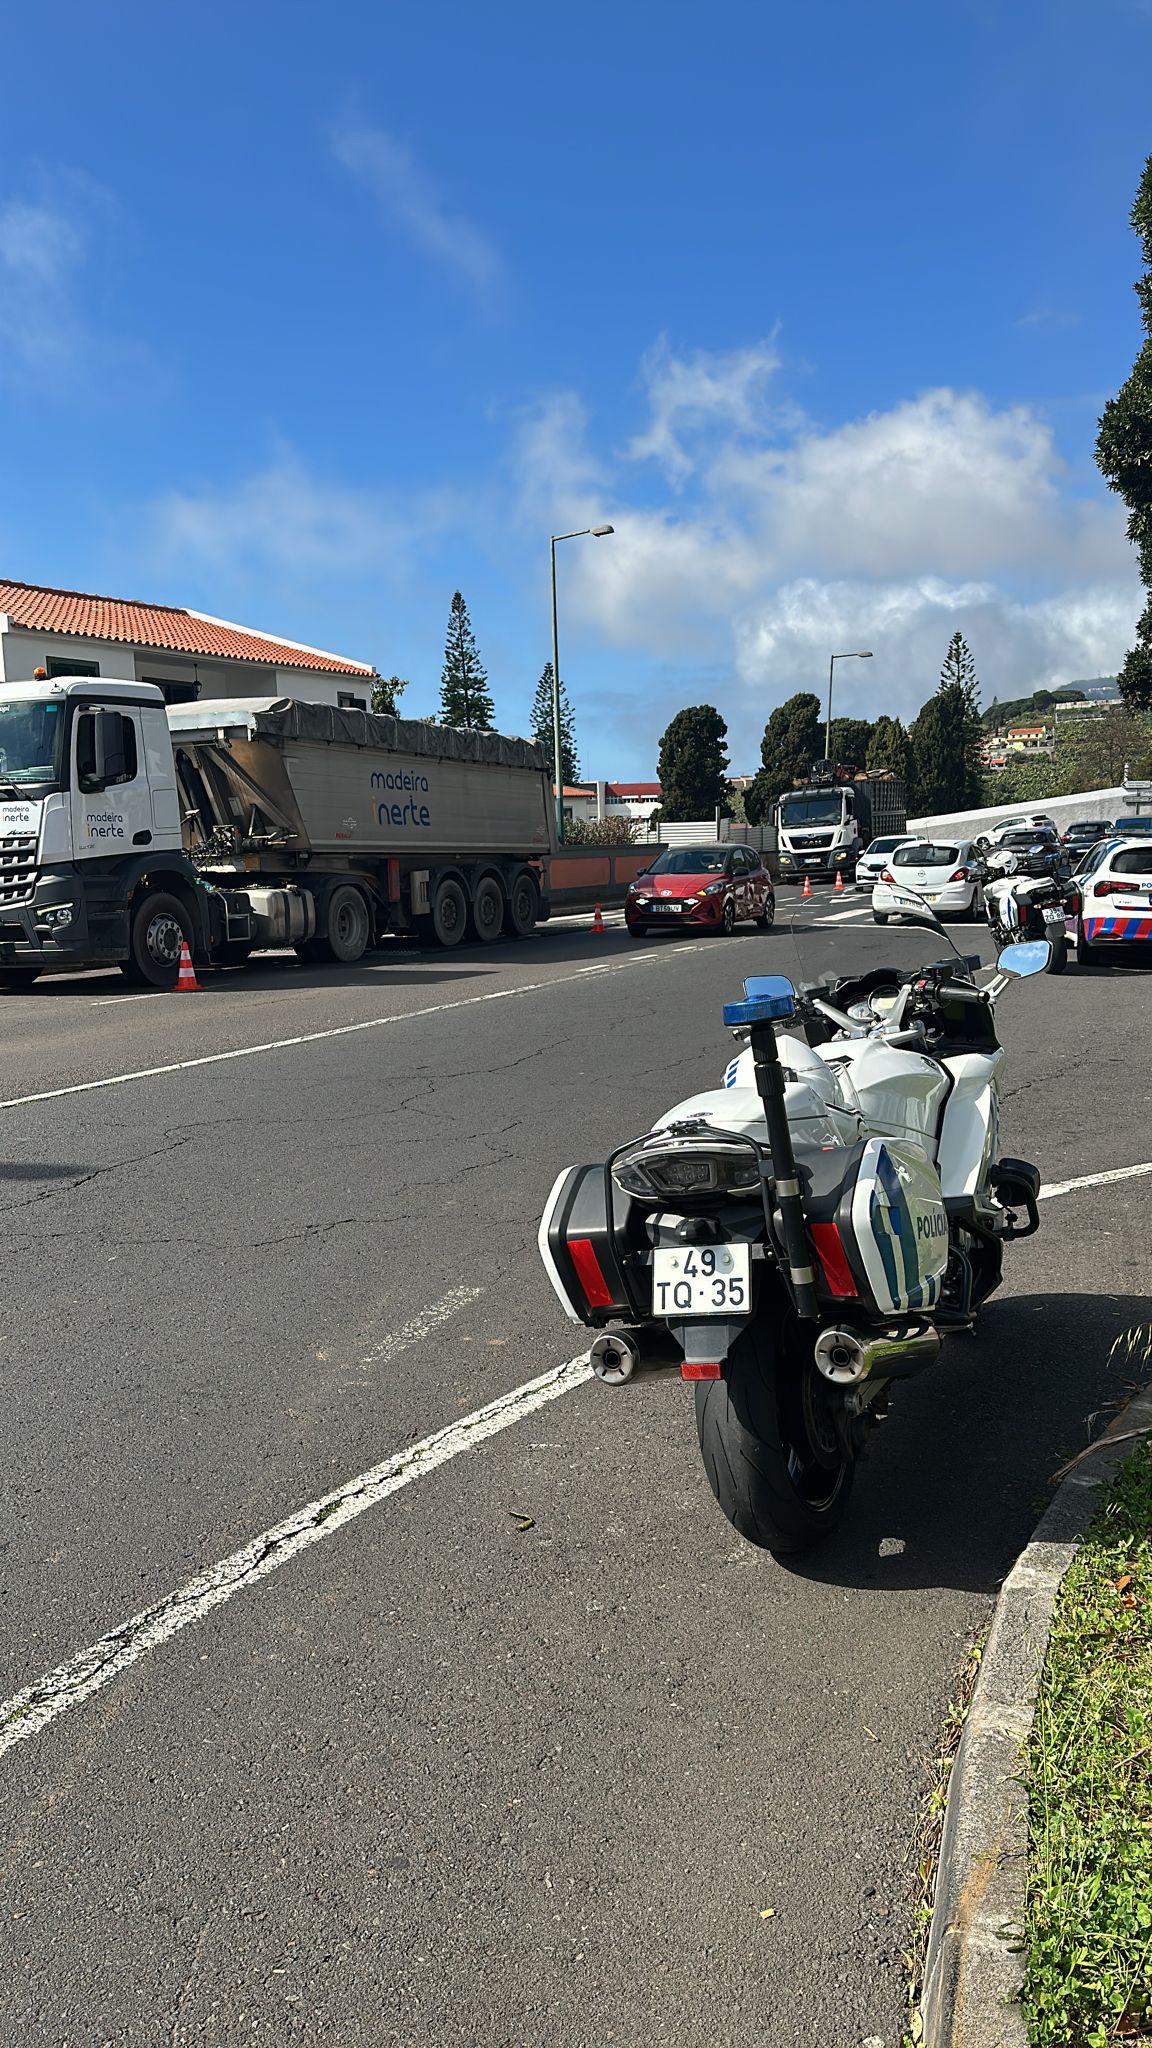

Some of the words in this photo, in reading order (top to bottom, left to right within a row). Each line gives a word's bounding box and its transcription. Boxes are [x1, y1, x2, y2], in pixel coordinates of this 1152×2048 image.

[371, 769, 429, 793] madeira
[2, 805, 30, 813] madeira
[371, 795, 431, 826] inerte
[2, 813, 30, 822] inerte
[86, 811, 124, 823] madeira
[87, 823, 125, 838] inerte
[683, 1249, 716, 1277] 49
